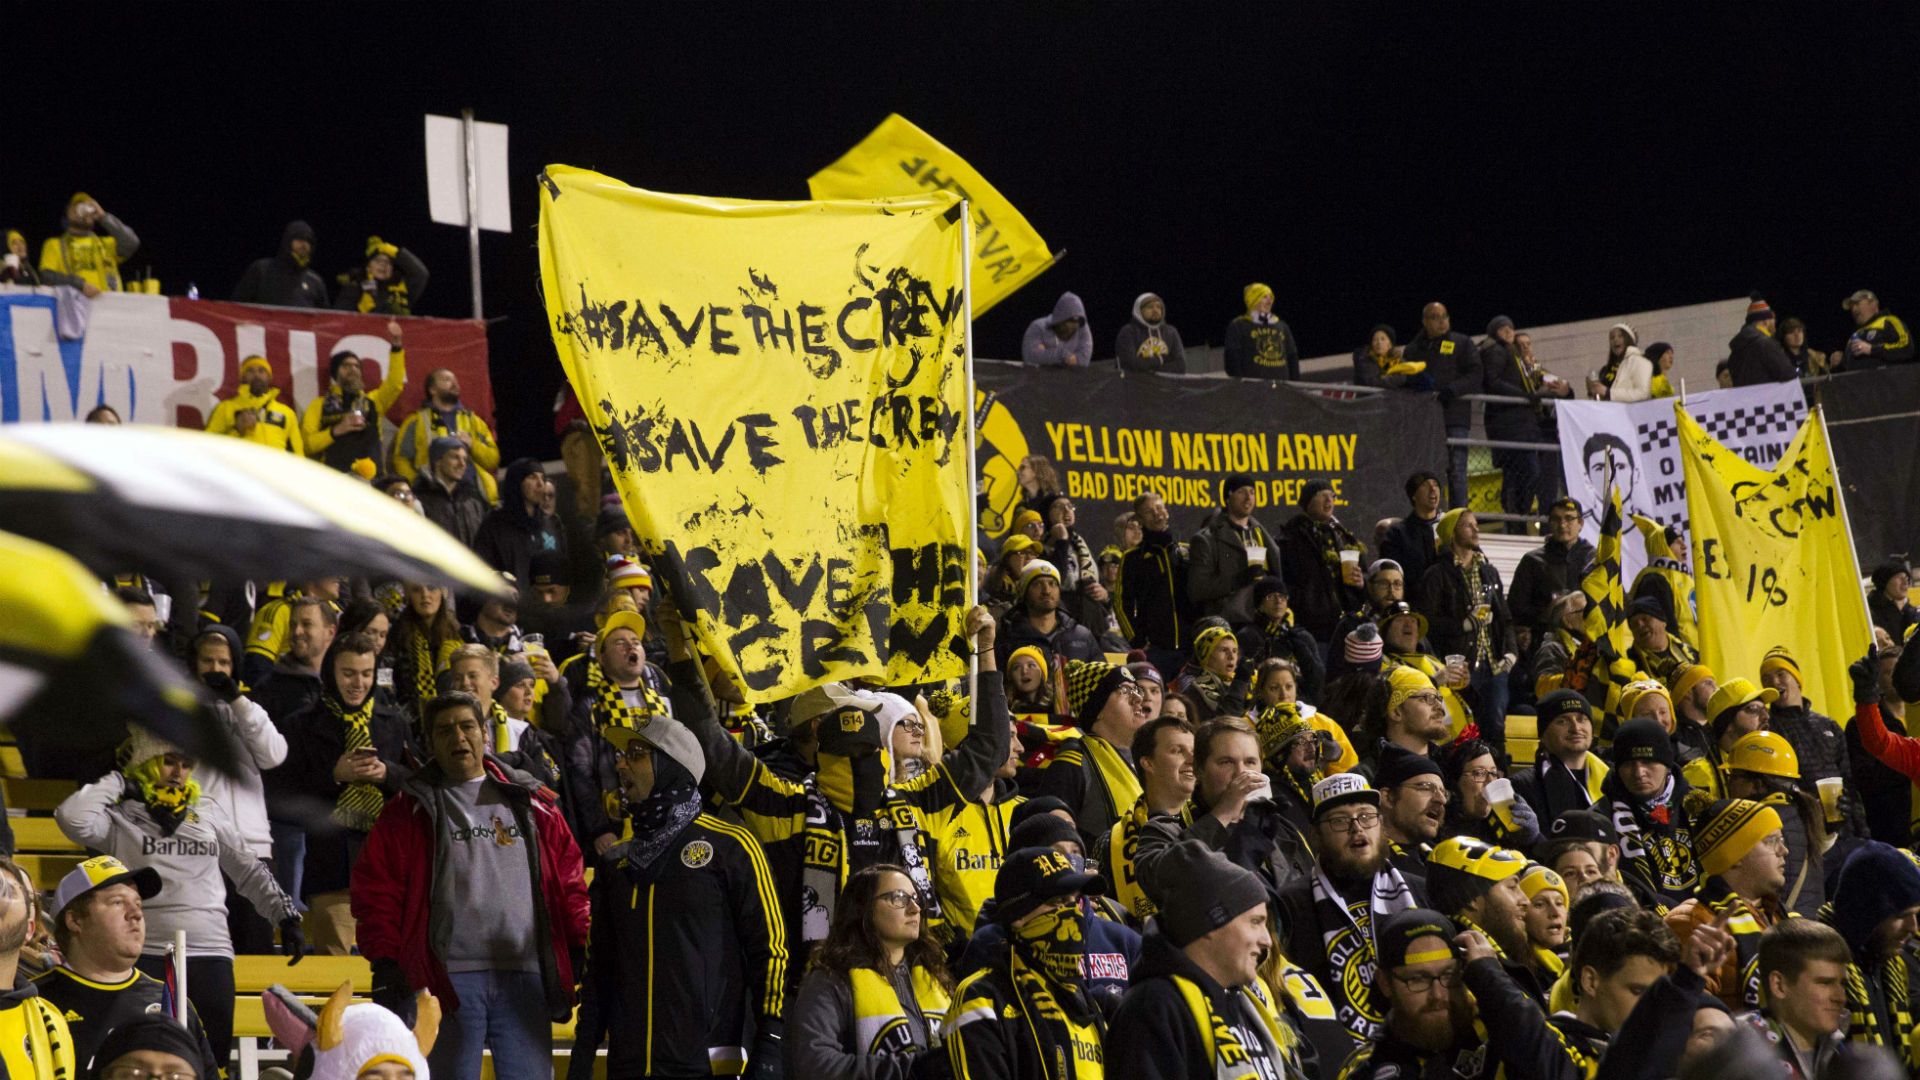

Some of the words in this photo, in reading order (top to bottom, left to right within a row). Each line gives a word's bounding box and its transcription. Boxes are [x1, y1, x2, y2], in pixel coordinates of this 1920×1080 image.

[1045, 420, 1164, 468] YELLOW
[1170, 431, 1270, 472] NATION
[1277, 433, 1358, 471] ARMY
[1067, 470, 1109, 500] BAD
[842, 713, 864, 726] 614
